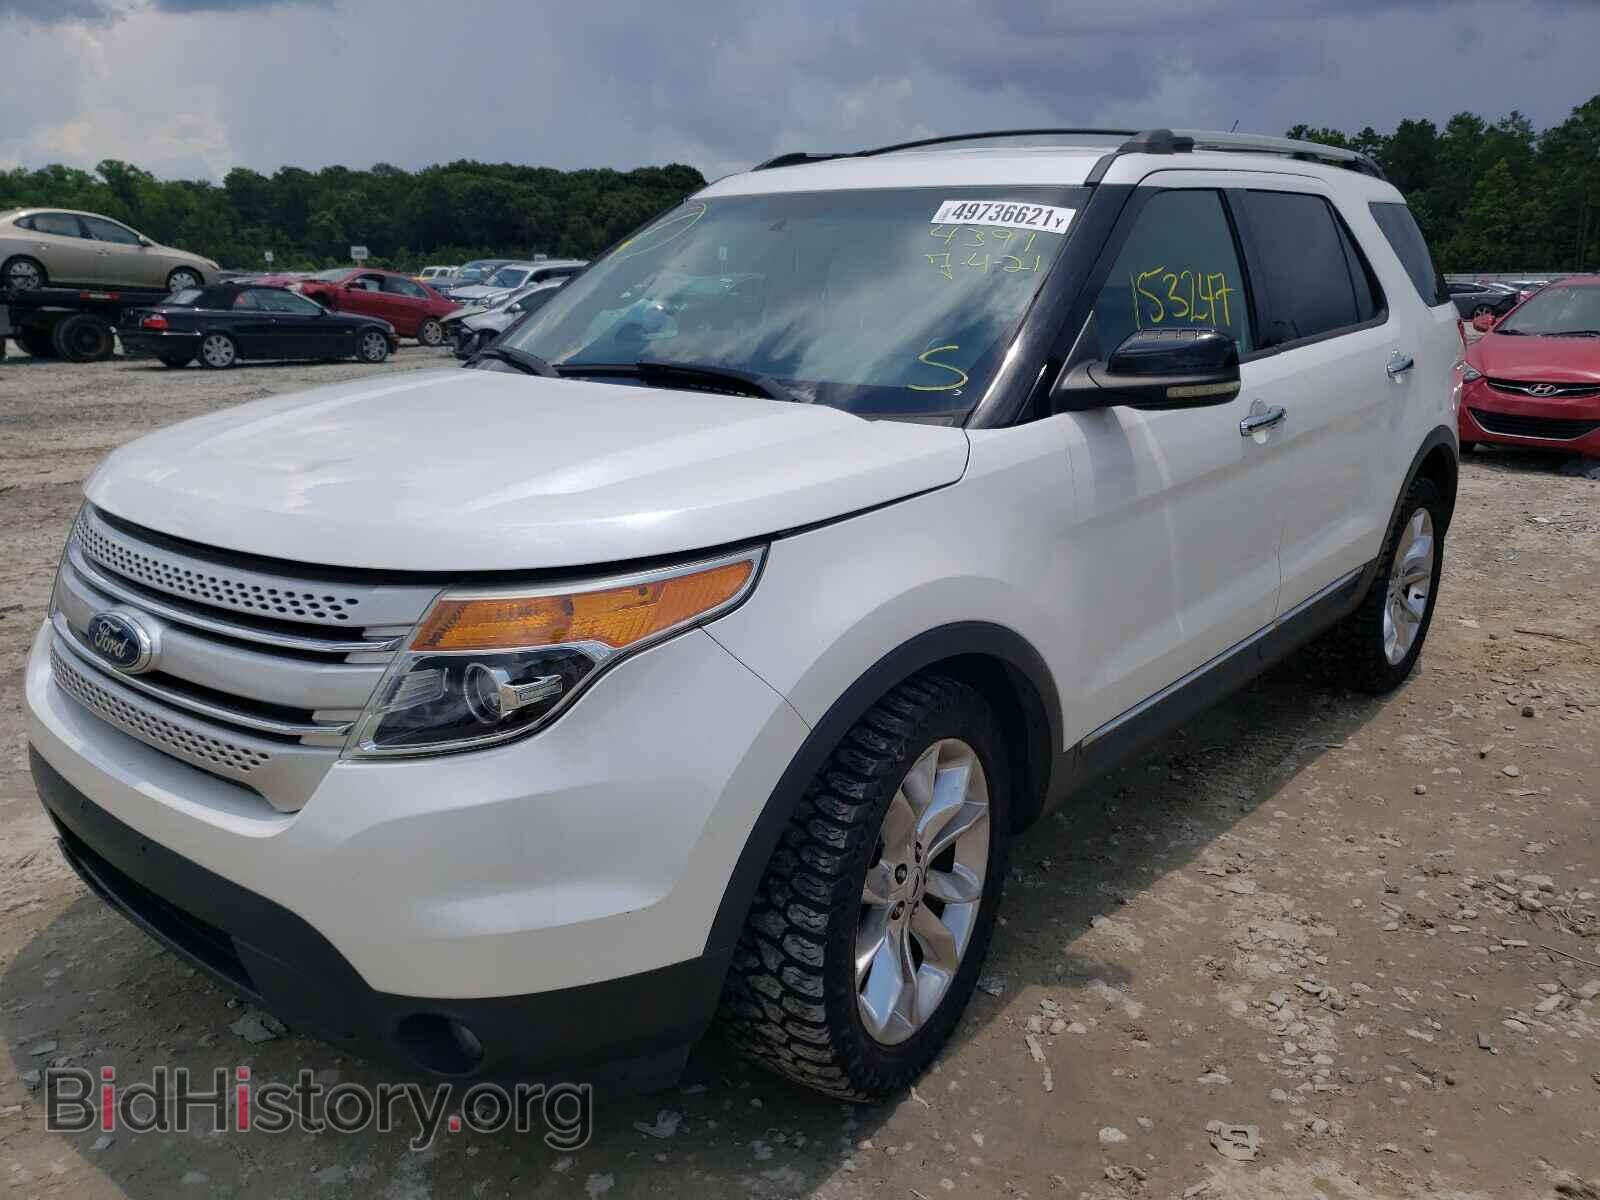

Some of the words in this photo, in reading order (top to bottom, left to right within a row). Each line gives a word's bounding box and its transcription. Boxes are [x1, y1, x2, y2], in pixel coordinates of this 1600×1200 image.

[951, 203, 1055, 226] 49736621
[929, 225, 1036, 252] 4391
[1129, 265, 1233, 330] 153247
[95, 619, 129, 659] Ford
